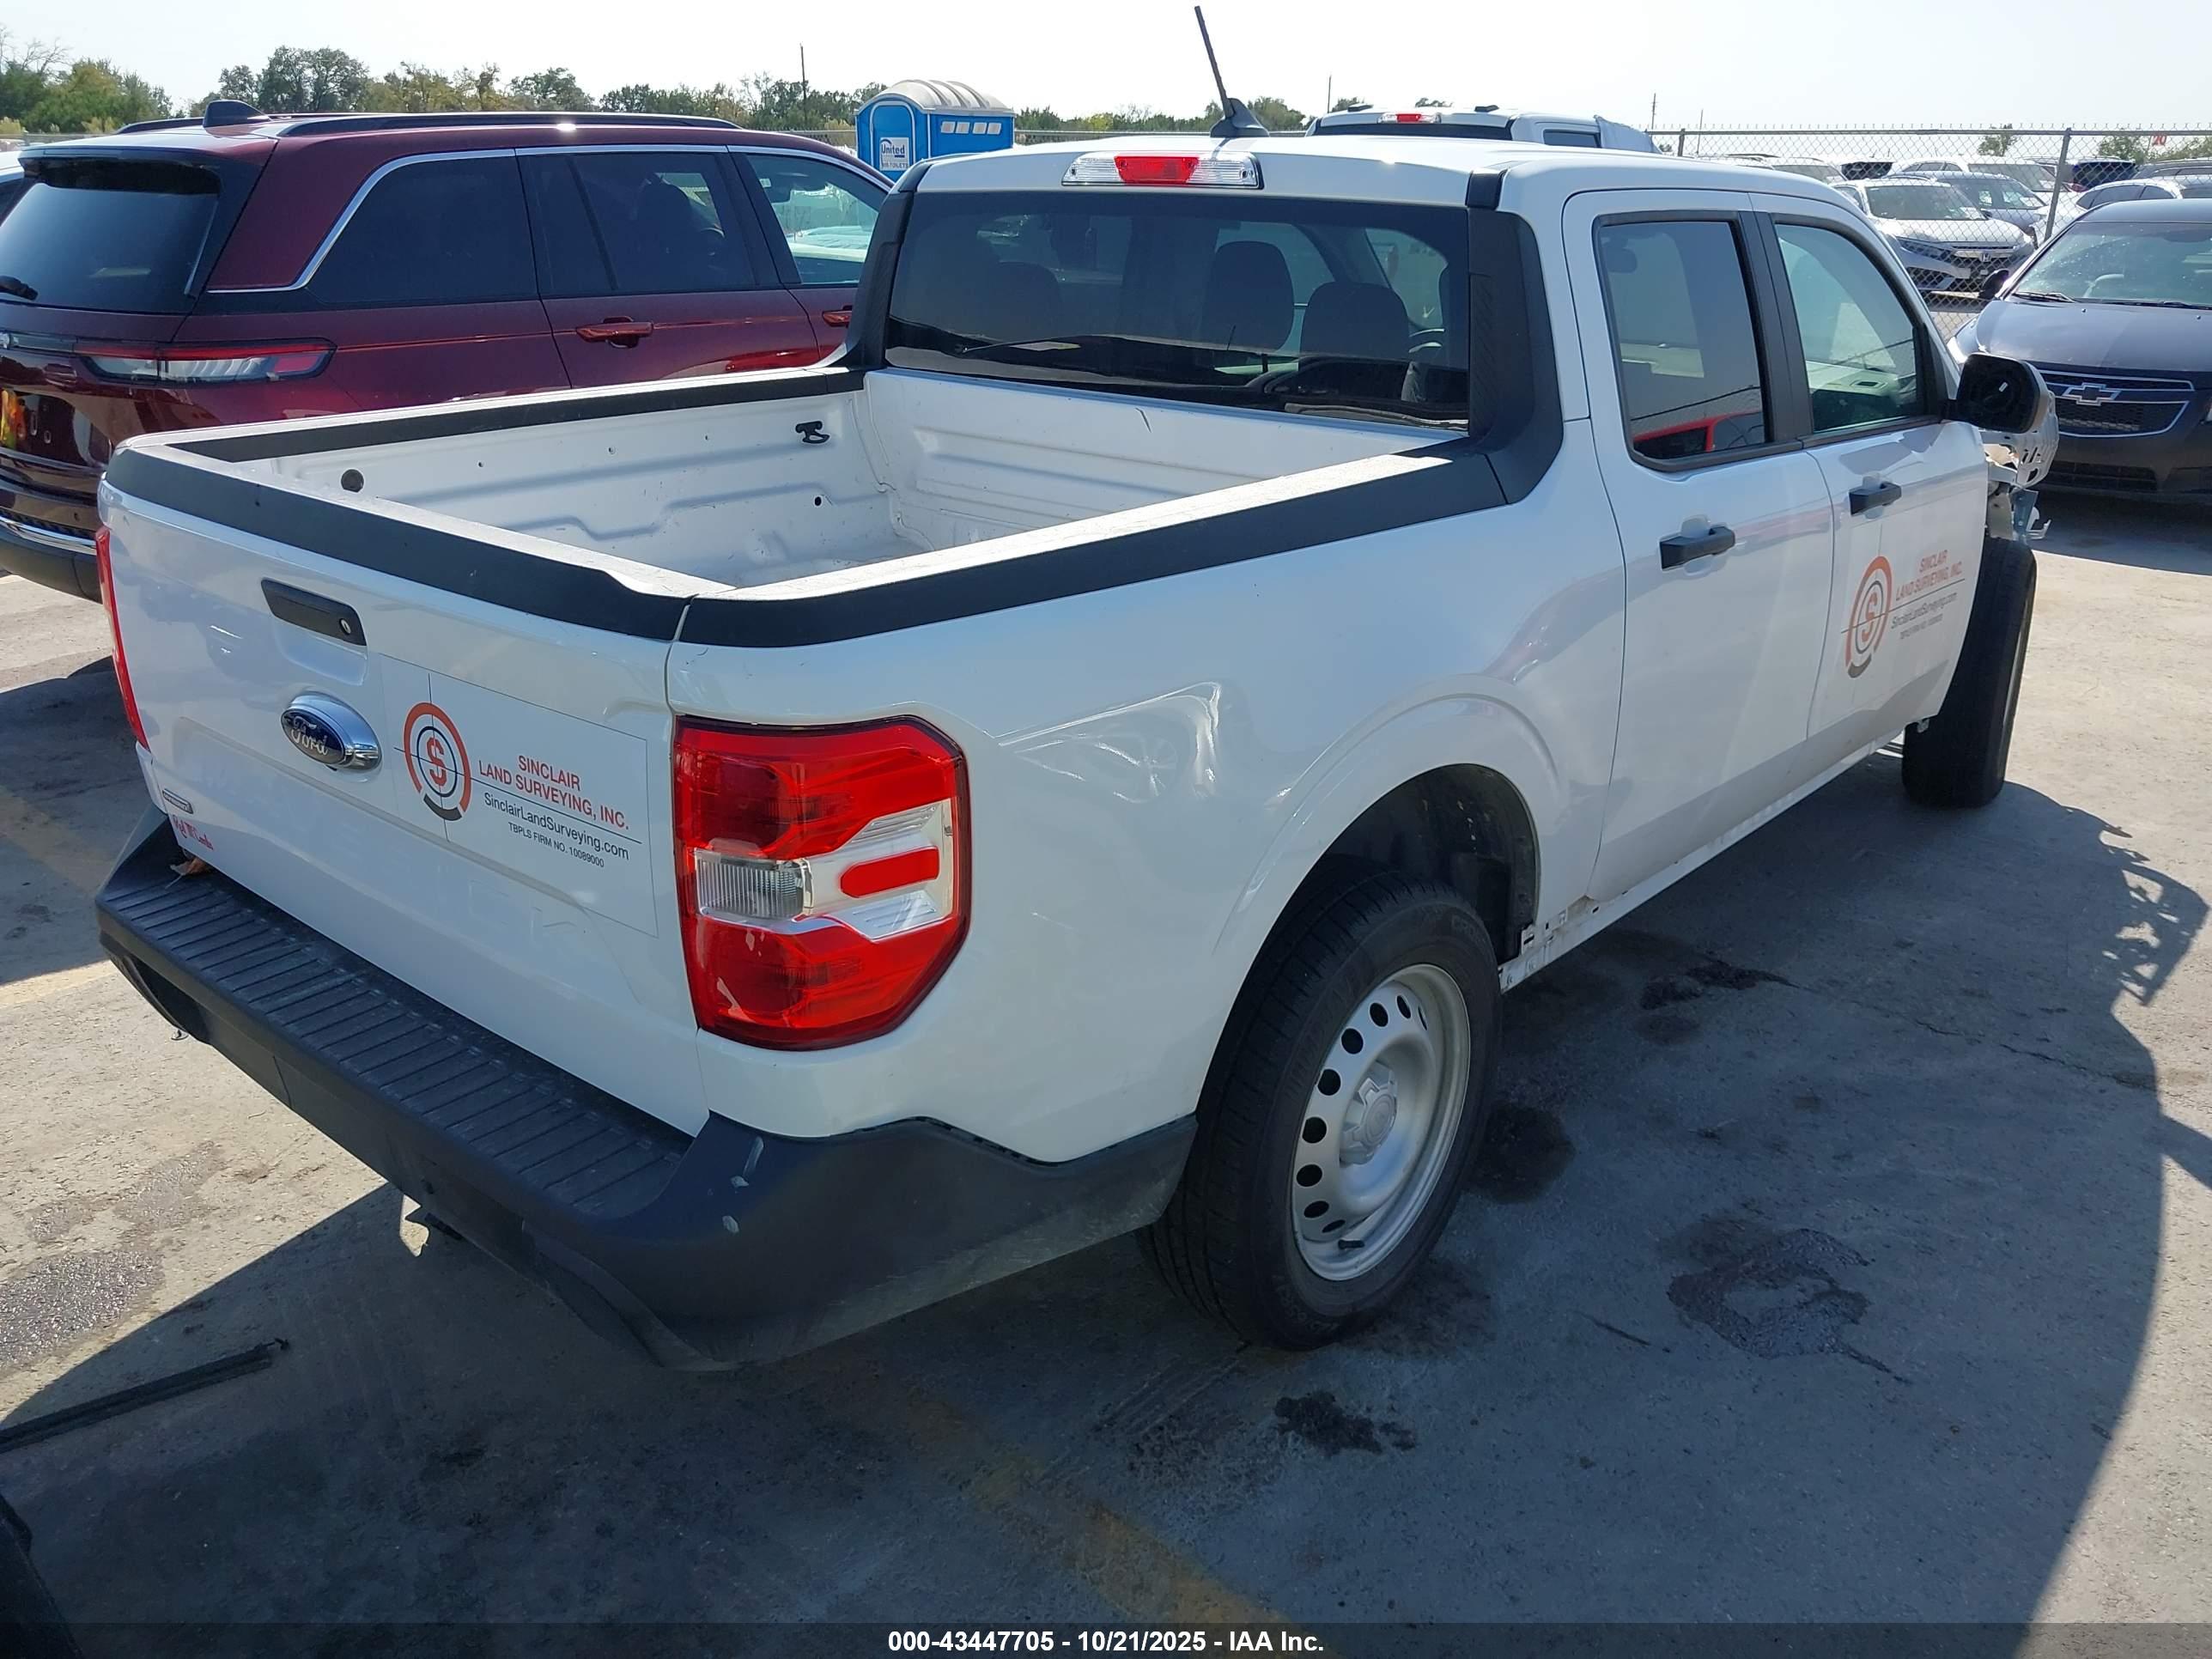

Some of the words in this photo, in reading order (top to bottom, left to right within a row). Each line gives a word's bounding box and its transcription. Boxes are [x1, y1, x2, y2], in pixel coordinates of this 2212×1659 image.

[881, 143, 905, 155] United
[290, 716, 328, 756] Ford
[478, 760, 512, 786] LAND
[515, 774, 597, 820] SURVEYING,
[600, 805, 629, 830] INC.
[518, 755, 580, 792] SINCLAIR
[484, 792, 629, 860] SinclairLandSurveying.com
[508, 821, 532, 839] TBPLS
[533, 832, 552, 848] FIRM
[554, 842, 568, 854] NO.
[569, 847, 605, 868] 10089000
